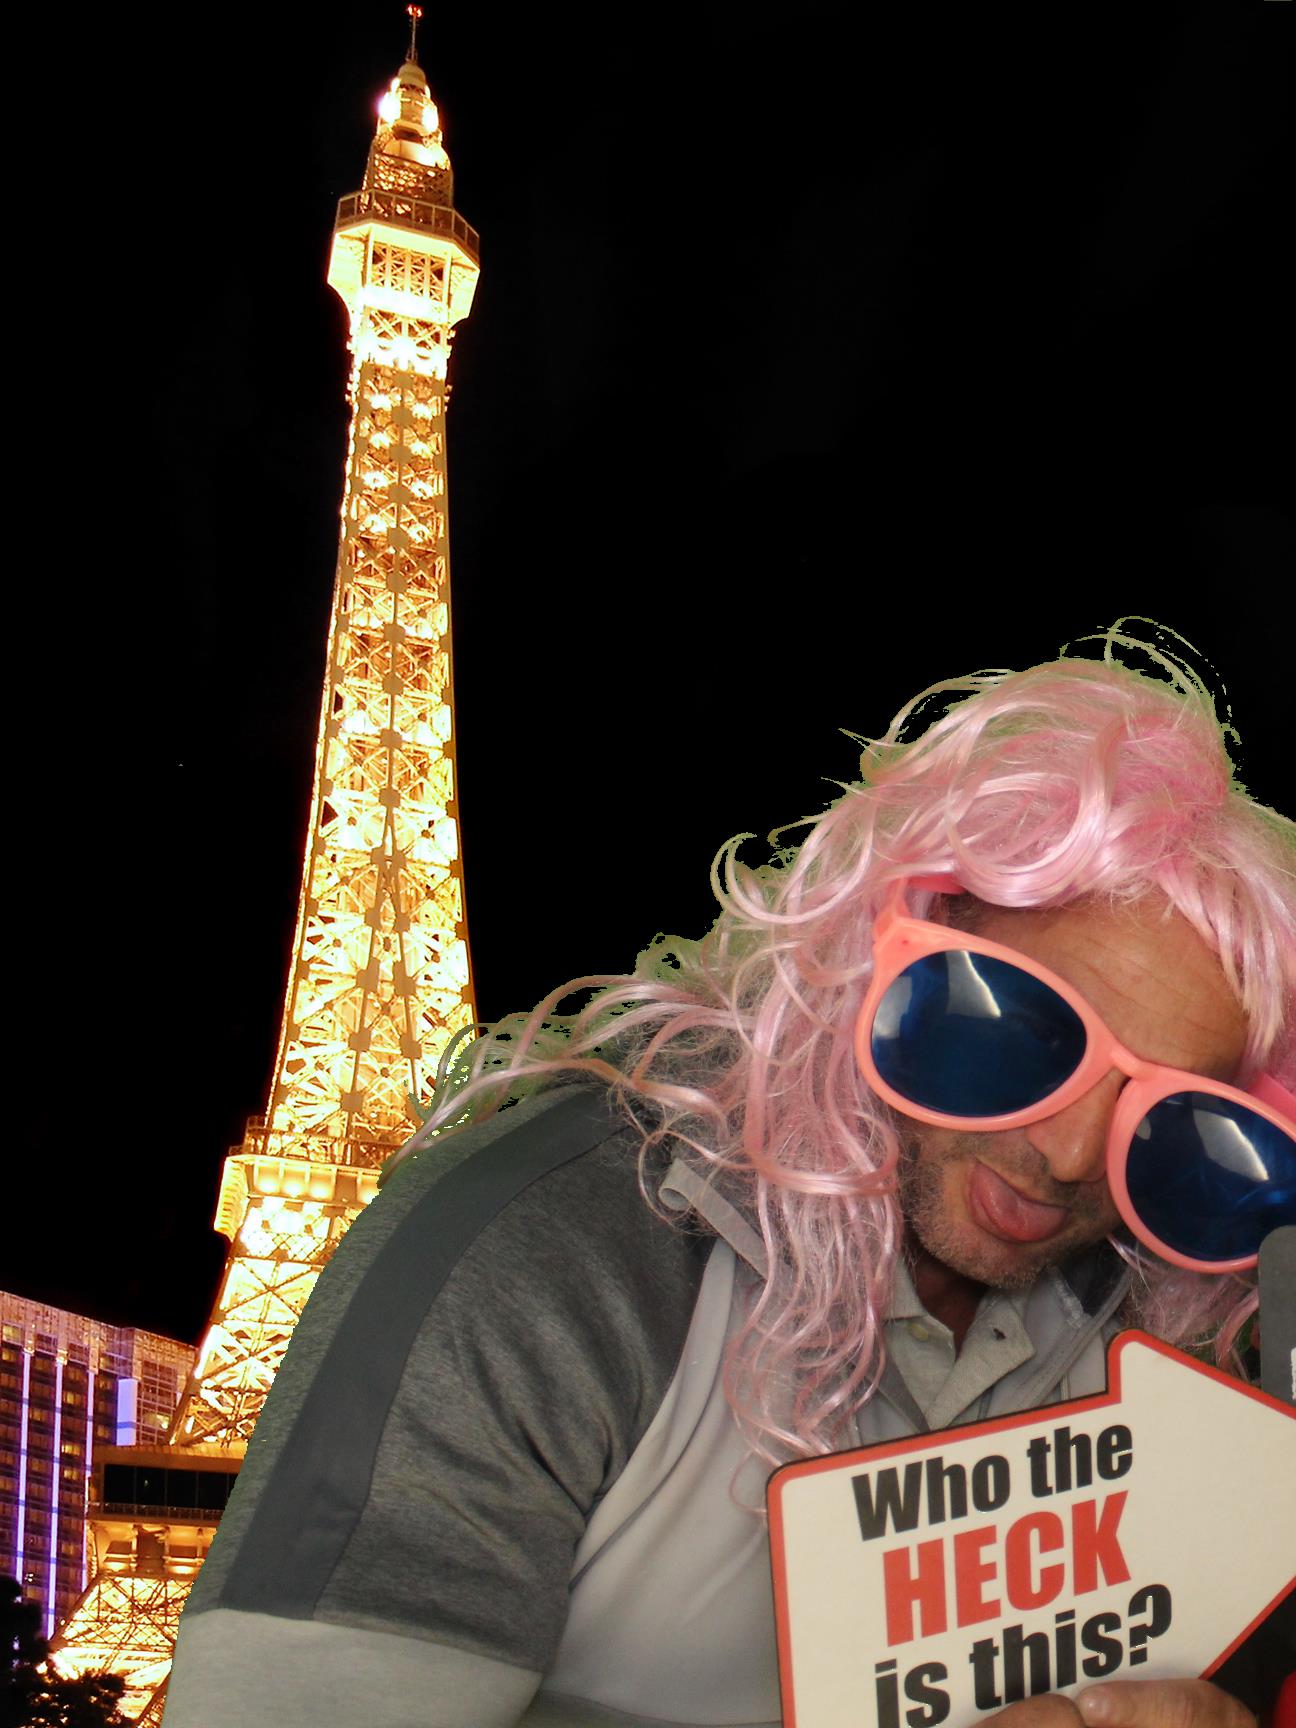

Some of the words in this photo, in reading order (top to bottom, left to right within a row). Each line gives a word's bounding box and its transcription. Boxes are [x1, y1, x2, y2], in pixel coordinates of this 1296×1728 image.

[851, 1456, 1012, 1542] Who
[1026, 1424, 1134, 1498] the
[882, 1490, 1132, 1648] HECK
[874, 1657, 951, 1728] is
[969, 1583, 1173, 1712] this?
